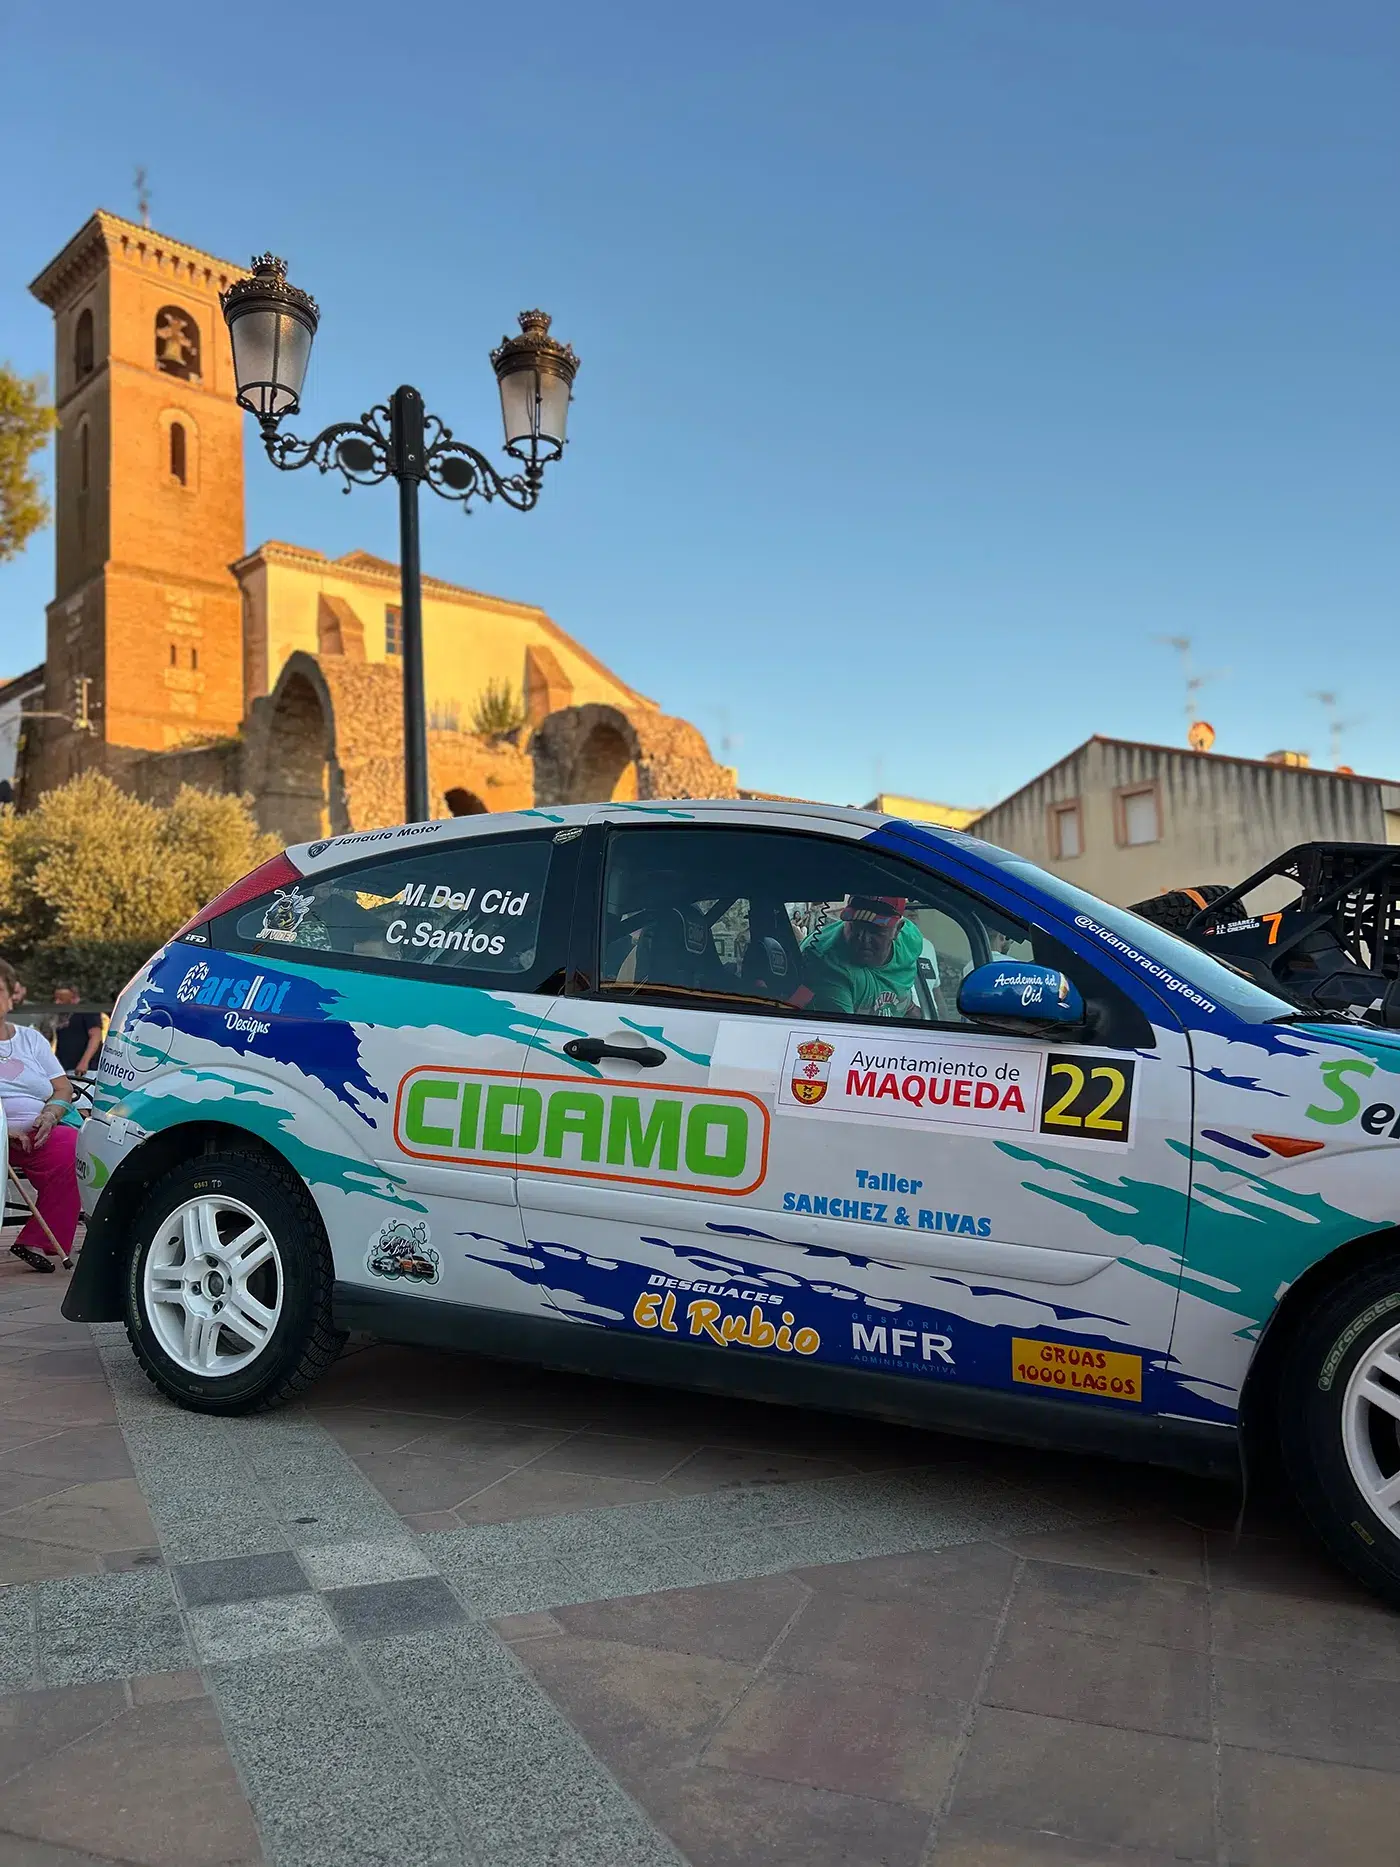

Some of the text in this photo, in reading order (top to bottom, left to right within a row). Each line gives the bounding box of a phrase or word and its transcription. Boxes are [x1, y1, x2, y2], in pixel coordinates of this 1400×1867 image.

[334, 824, 442, 846] Janauto Motor
[399, 882, 530, 916] M.Del Cid
[386, 919, 506, 955] C.Santos
[1262, 912, 1283, 945] 7
[994, 973, 1057, 988] Academia del
[1074, 915, 1217, 1014] @cidamoracingteam
[1021, 985, 1043, 1007] Cid
[224, 1011, 271, 1043] Designs
[100, 1056, 135, 1082] Montero
[850, 1050, 1021, 1082] Ayuntamiento de
[845, 1069, 1026, 1113] MAQUEDA
[1044, 1063, 1126, 1132] 22
[405, 1078, 749, 1179] CIDAMO
[855, 1169, 923, 1195] Taller
[782, 1192, 992, 1237] SANCHEZ & RIVAS
[647, 1273, 784, 1305] DESGUACES
[633, 1290, 821, 1355] El Rubio
[852, 1322, 956, 1365] MFR
[1040, 1345, 1107, 1369] GRUAS
[852, 1354, 957, 1375] ADMINISTRATIVA
[1017, 1364, 1136, 1395] 1000 LAGOS
